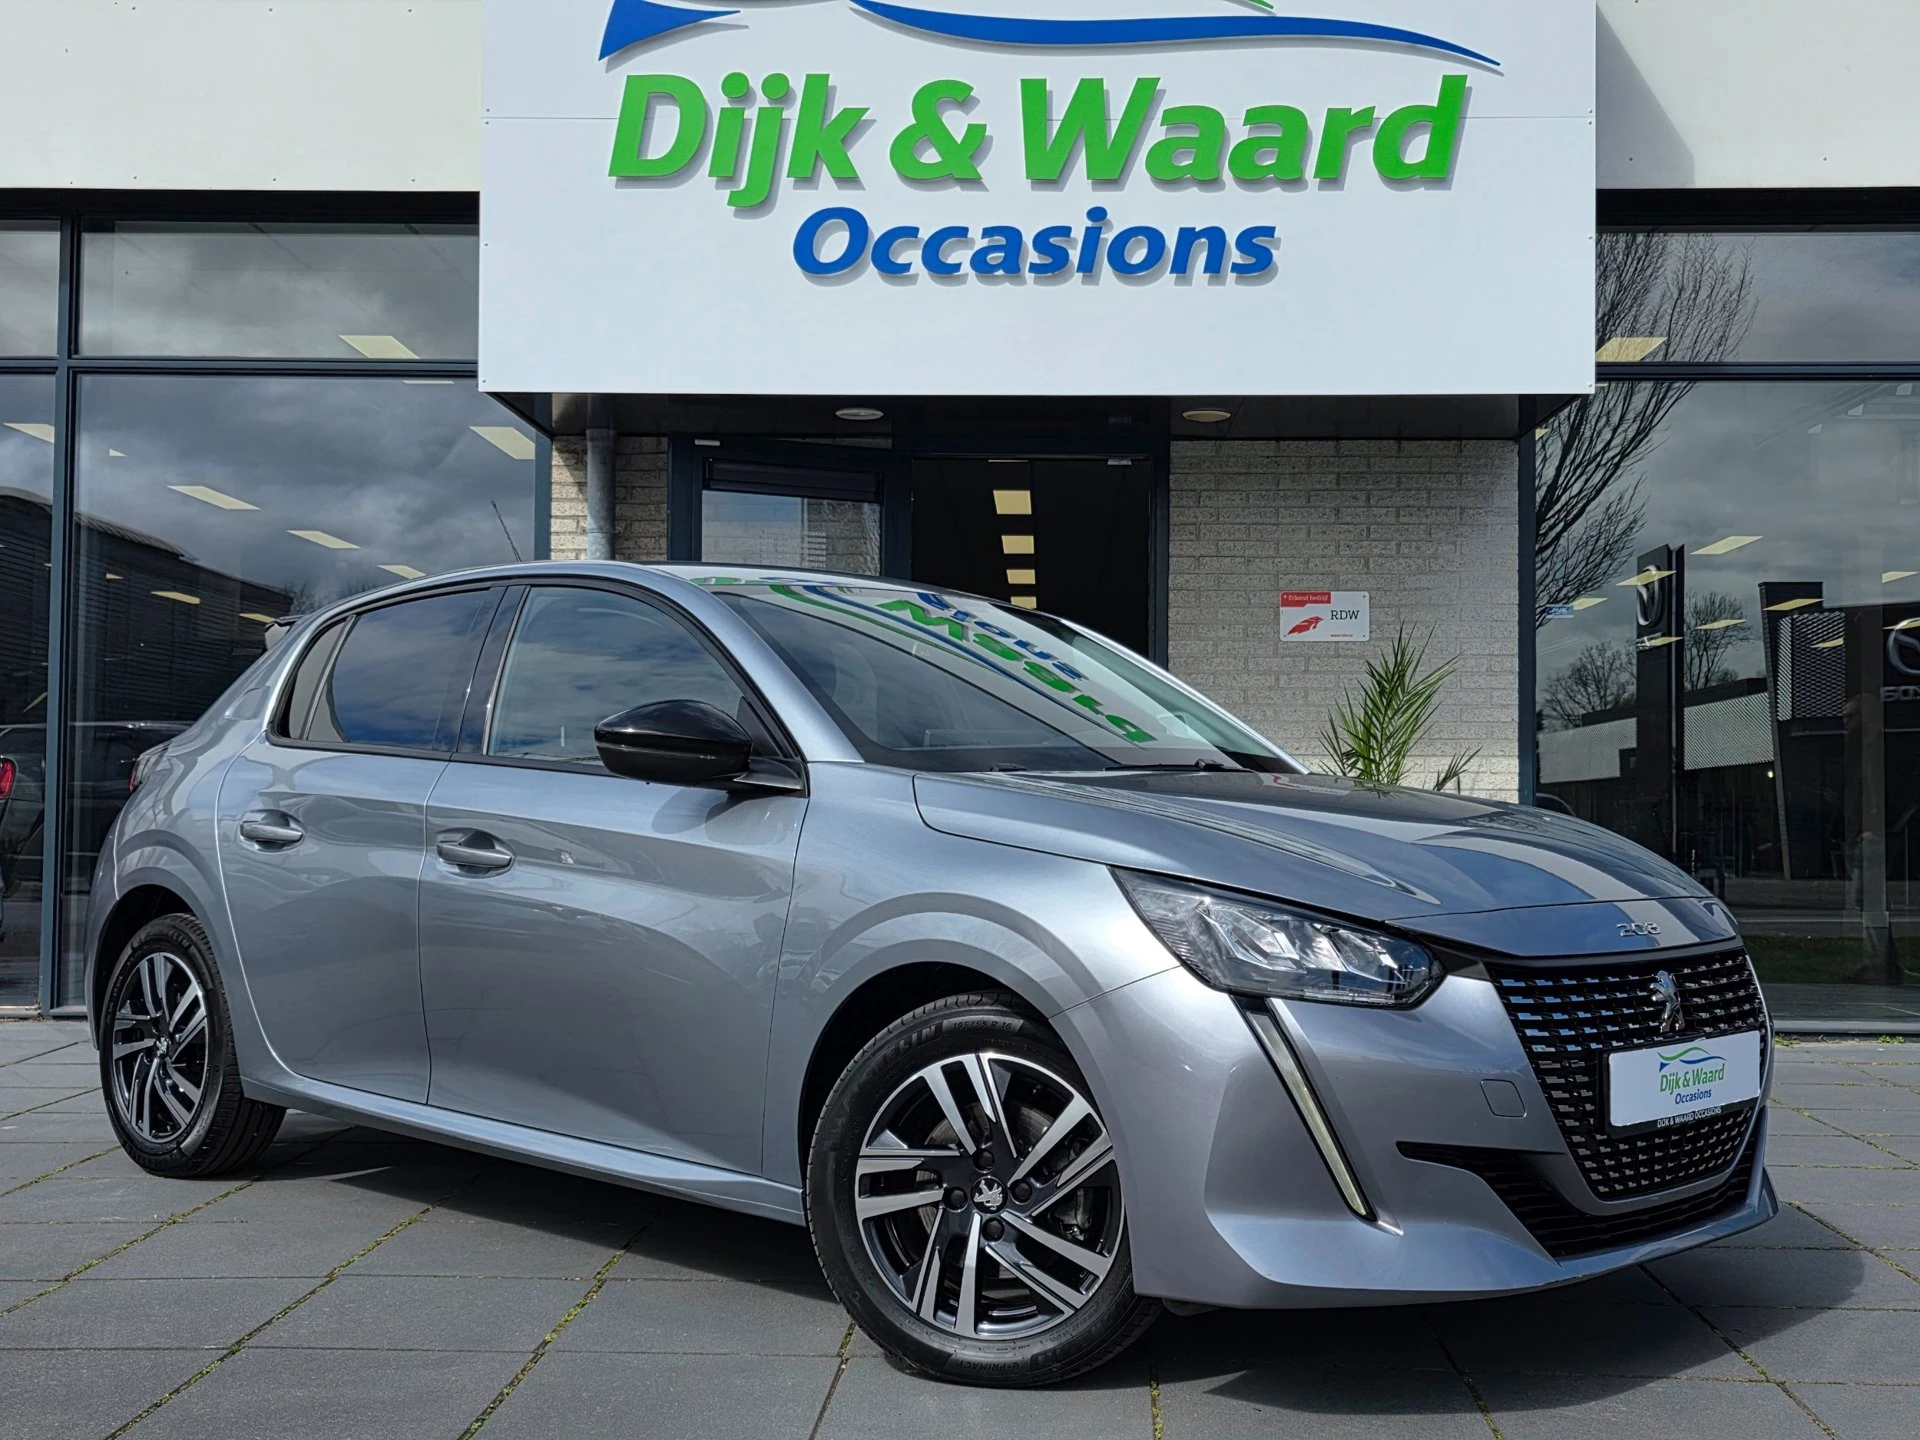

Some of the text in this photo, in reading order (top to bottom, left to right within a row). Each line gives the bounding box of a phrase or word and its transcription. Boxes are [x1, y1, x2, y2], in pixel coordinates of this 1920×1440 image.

[609, 73, 1468, 207] Dijk & Waard
[793, 206, 1277, 276] Occasions
[1330, 609, 1360, 620] RDW
[1616, 921, 1661, 937] 208
[953, 1021, 1012, 1031] 195/55 R 16
[1659, 1063, 1725, 1095] Dijk & Waard
[1674, 1089, 1712, 1105] Occasions
[1674, 1112, 1694, 1124] WAARD
[1694, 1106, 1722, 1120] OCCASIONS
